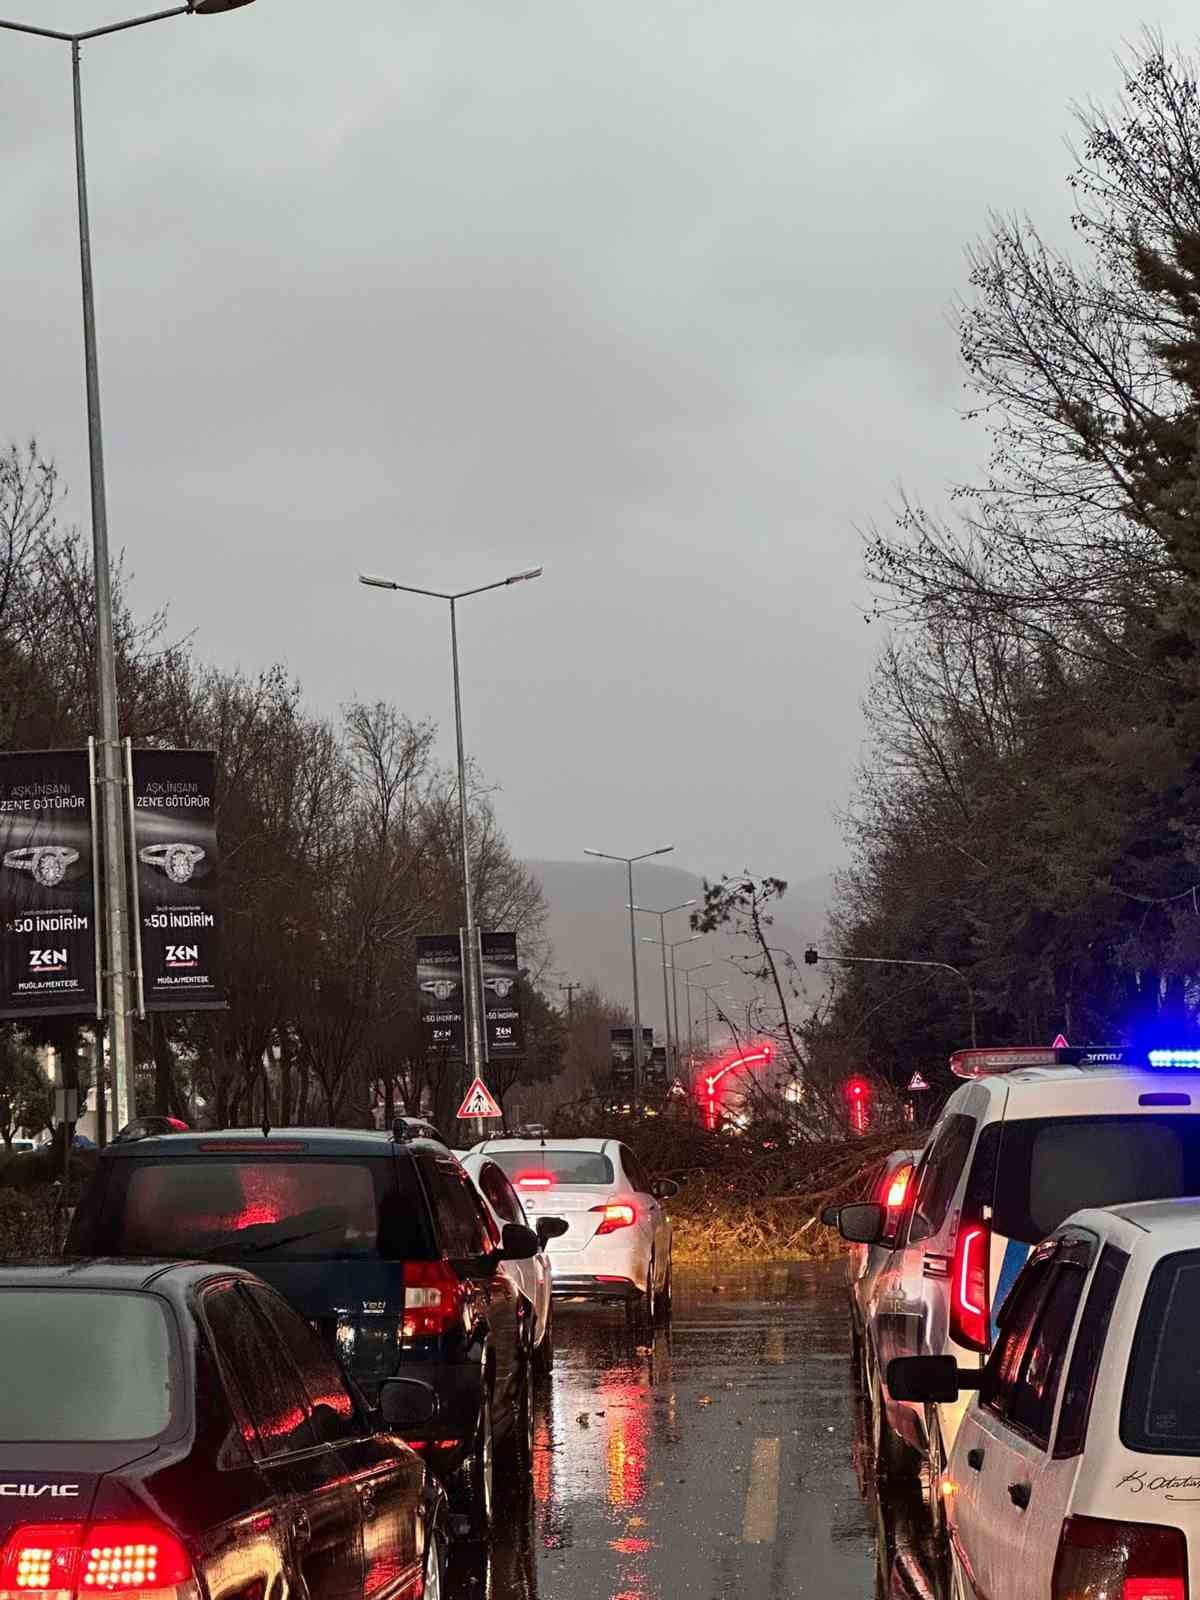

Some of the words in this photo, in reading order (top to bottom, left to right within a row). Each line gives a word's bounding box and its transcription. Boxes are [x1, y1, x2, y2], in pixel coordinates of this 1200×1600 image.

[165, 794, 211, 807] GÖTÜRÜR
[36, 915, 88, 931] İNDİRİM
[144, 914, 168, 928] %50
[170, 911, 214, 927] İNDİRİM
[29, 949, 68, 965] ZEN
[165, 945, 199, 960] ZEN
[495, 1026, 512, 1036] ZEN
[0, 1484, 79, 1497] CIVIC
